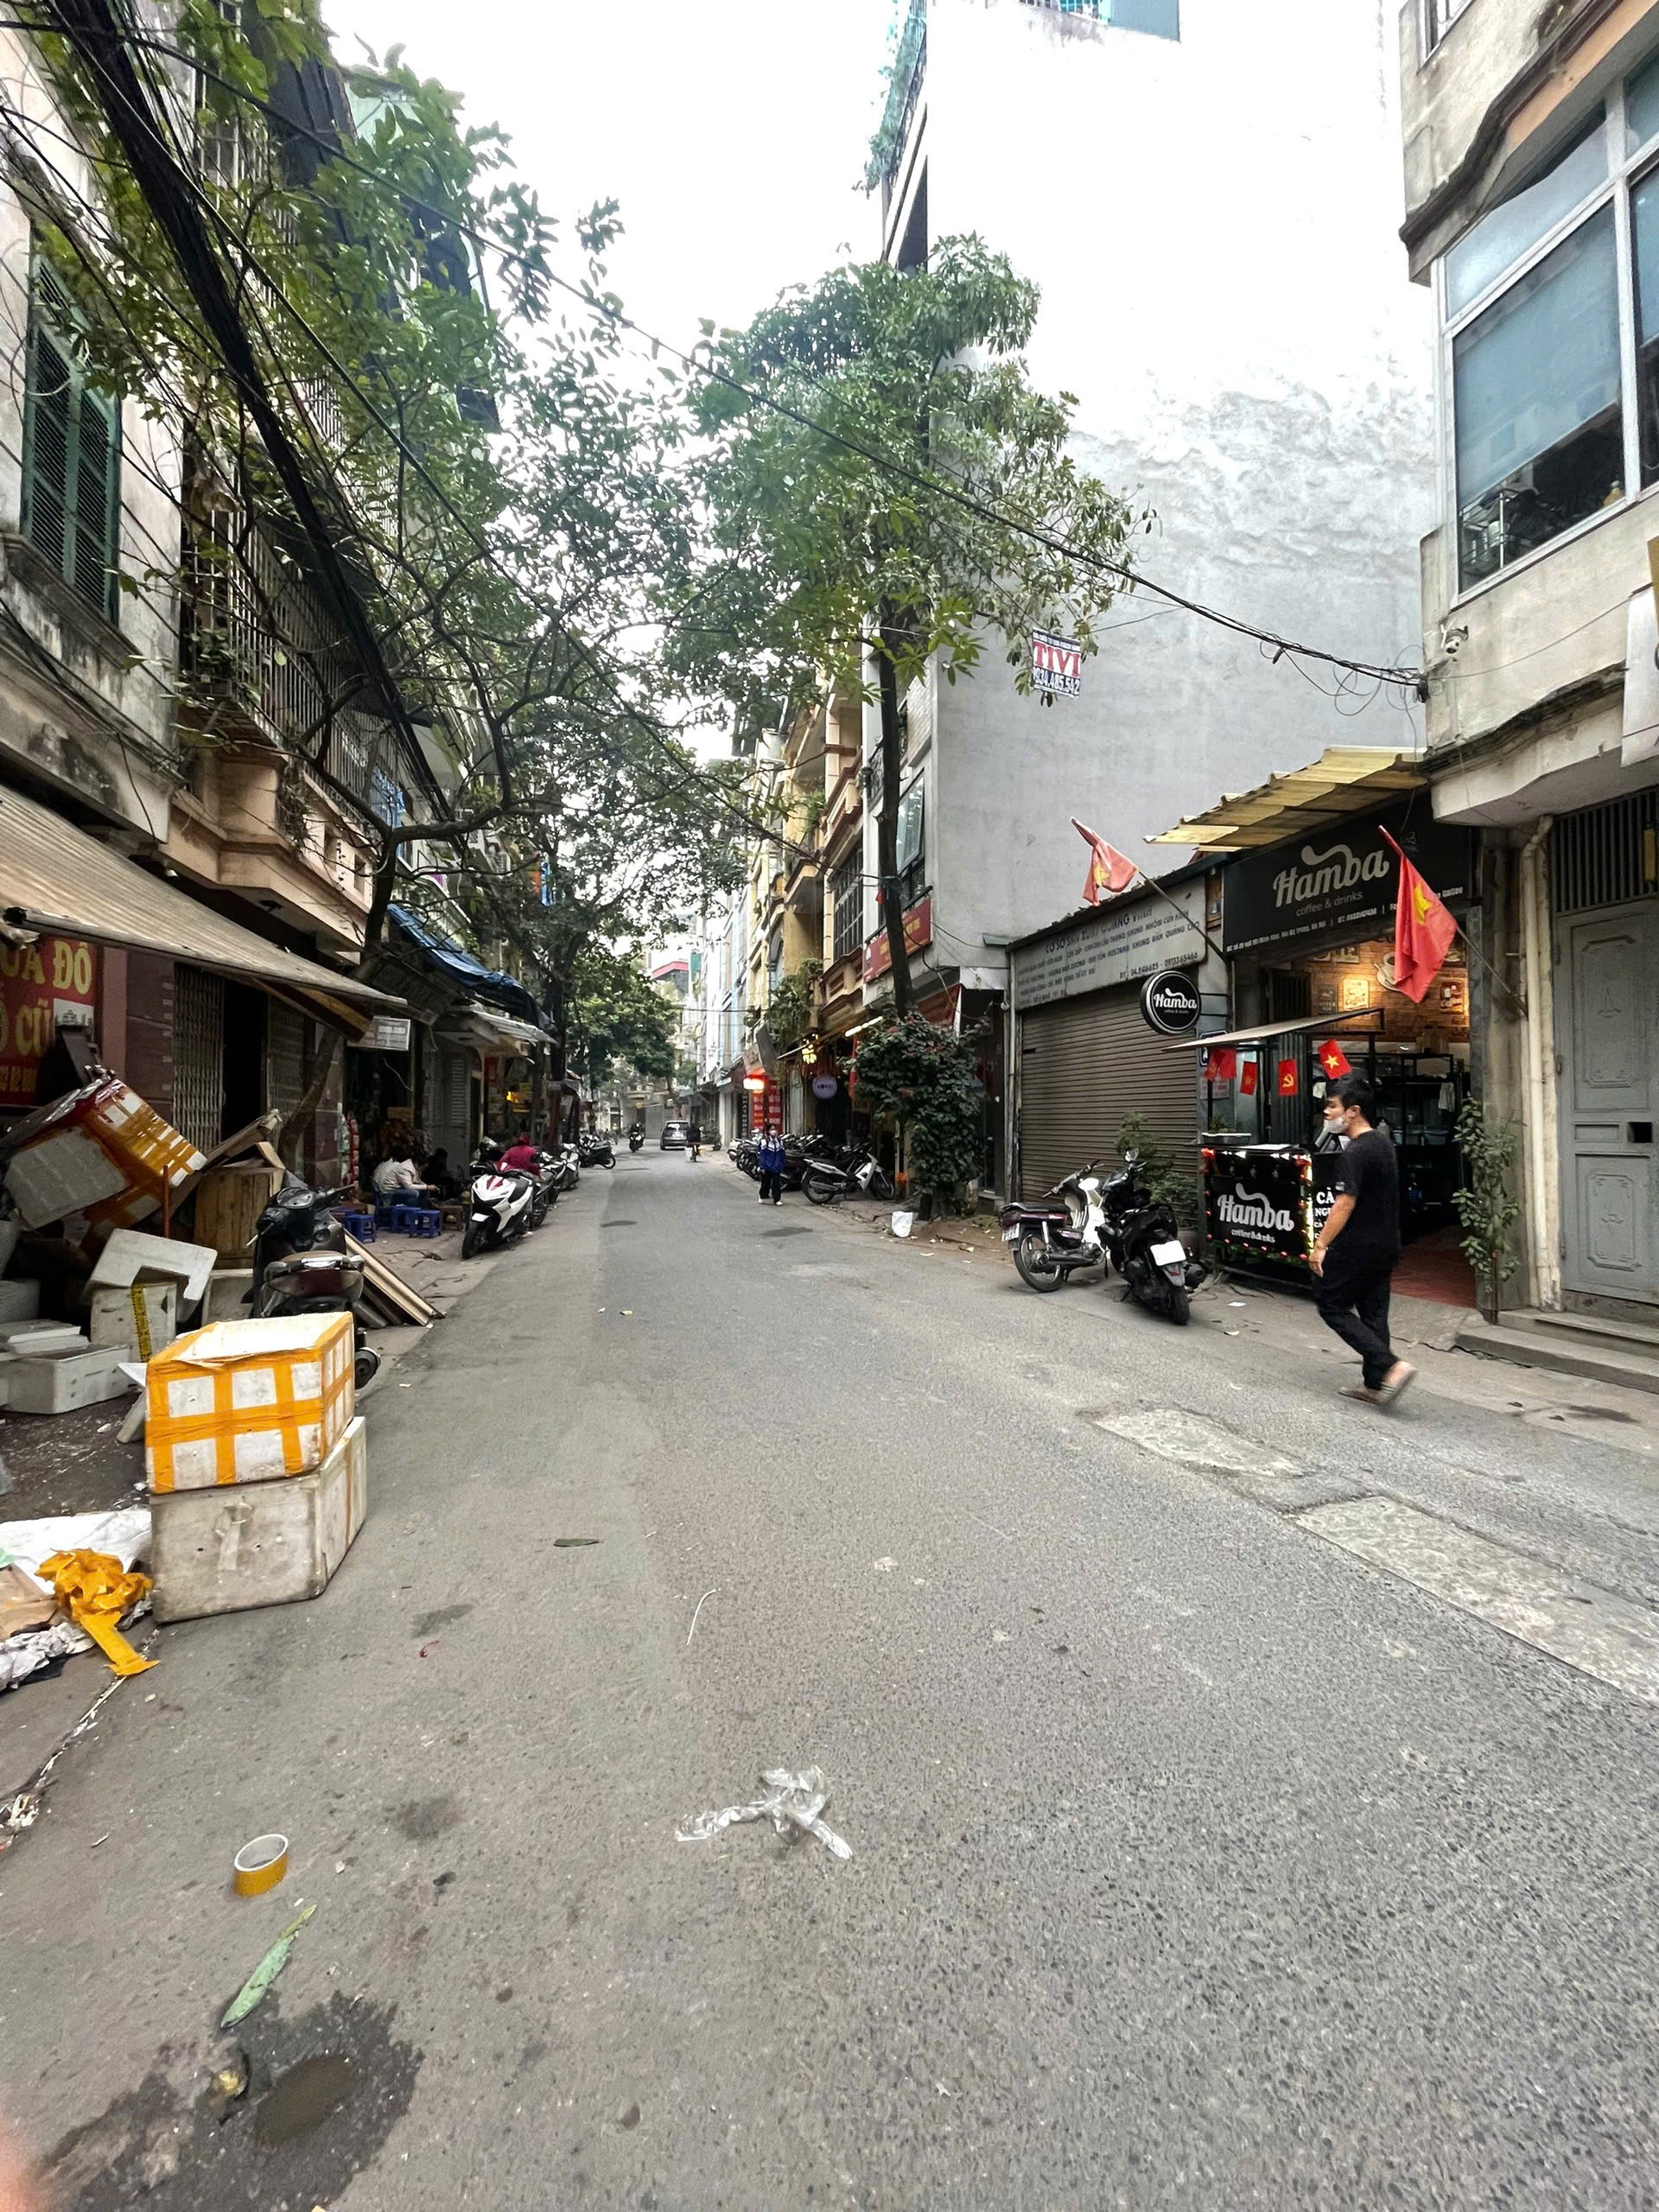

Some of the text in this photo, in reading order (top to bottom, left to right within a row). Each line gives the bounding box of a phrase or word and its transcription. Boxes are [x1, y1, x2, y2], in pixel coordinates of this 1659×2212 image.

[1033, 640, 1080, 677] TIVI
[1273, 844, 1389, 907] Hamba
[1296, 892, 1363, 917] coffee & drinks
[1154, 988, 1198, 1009] Hamba
[1217, 1183, 1294, 1231] Hamba
[1316, 1186, 1336, 1205] CÀ
